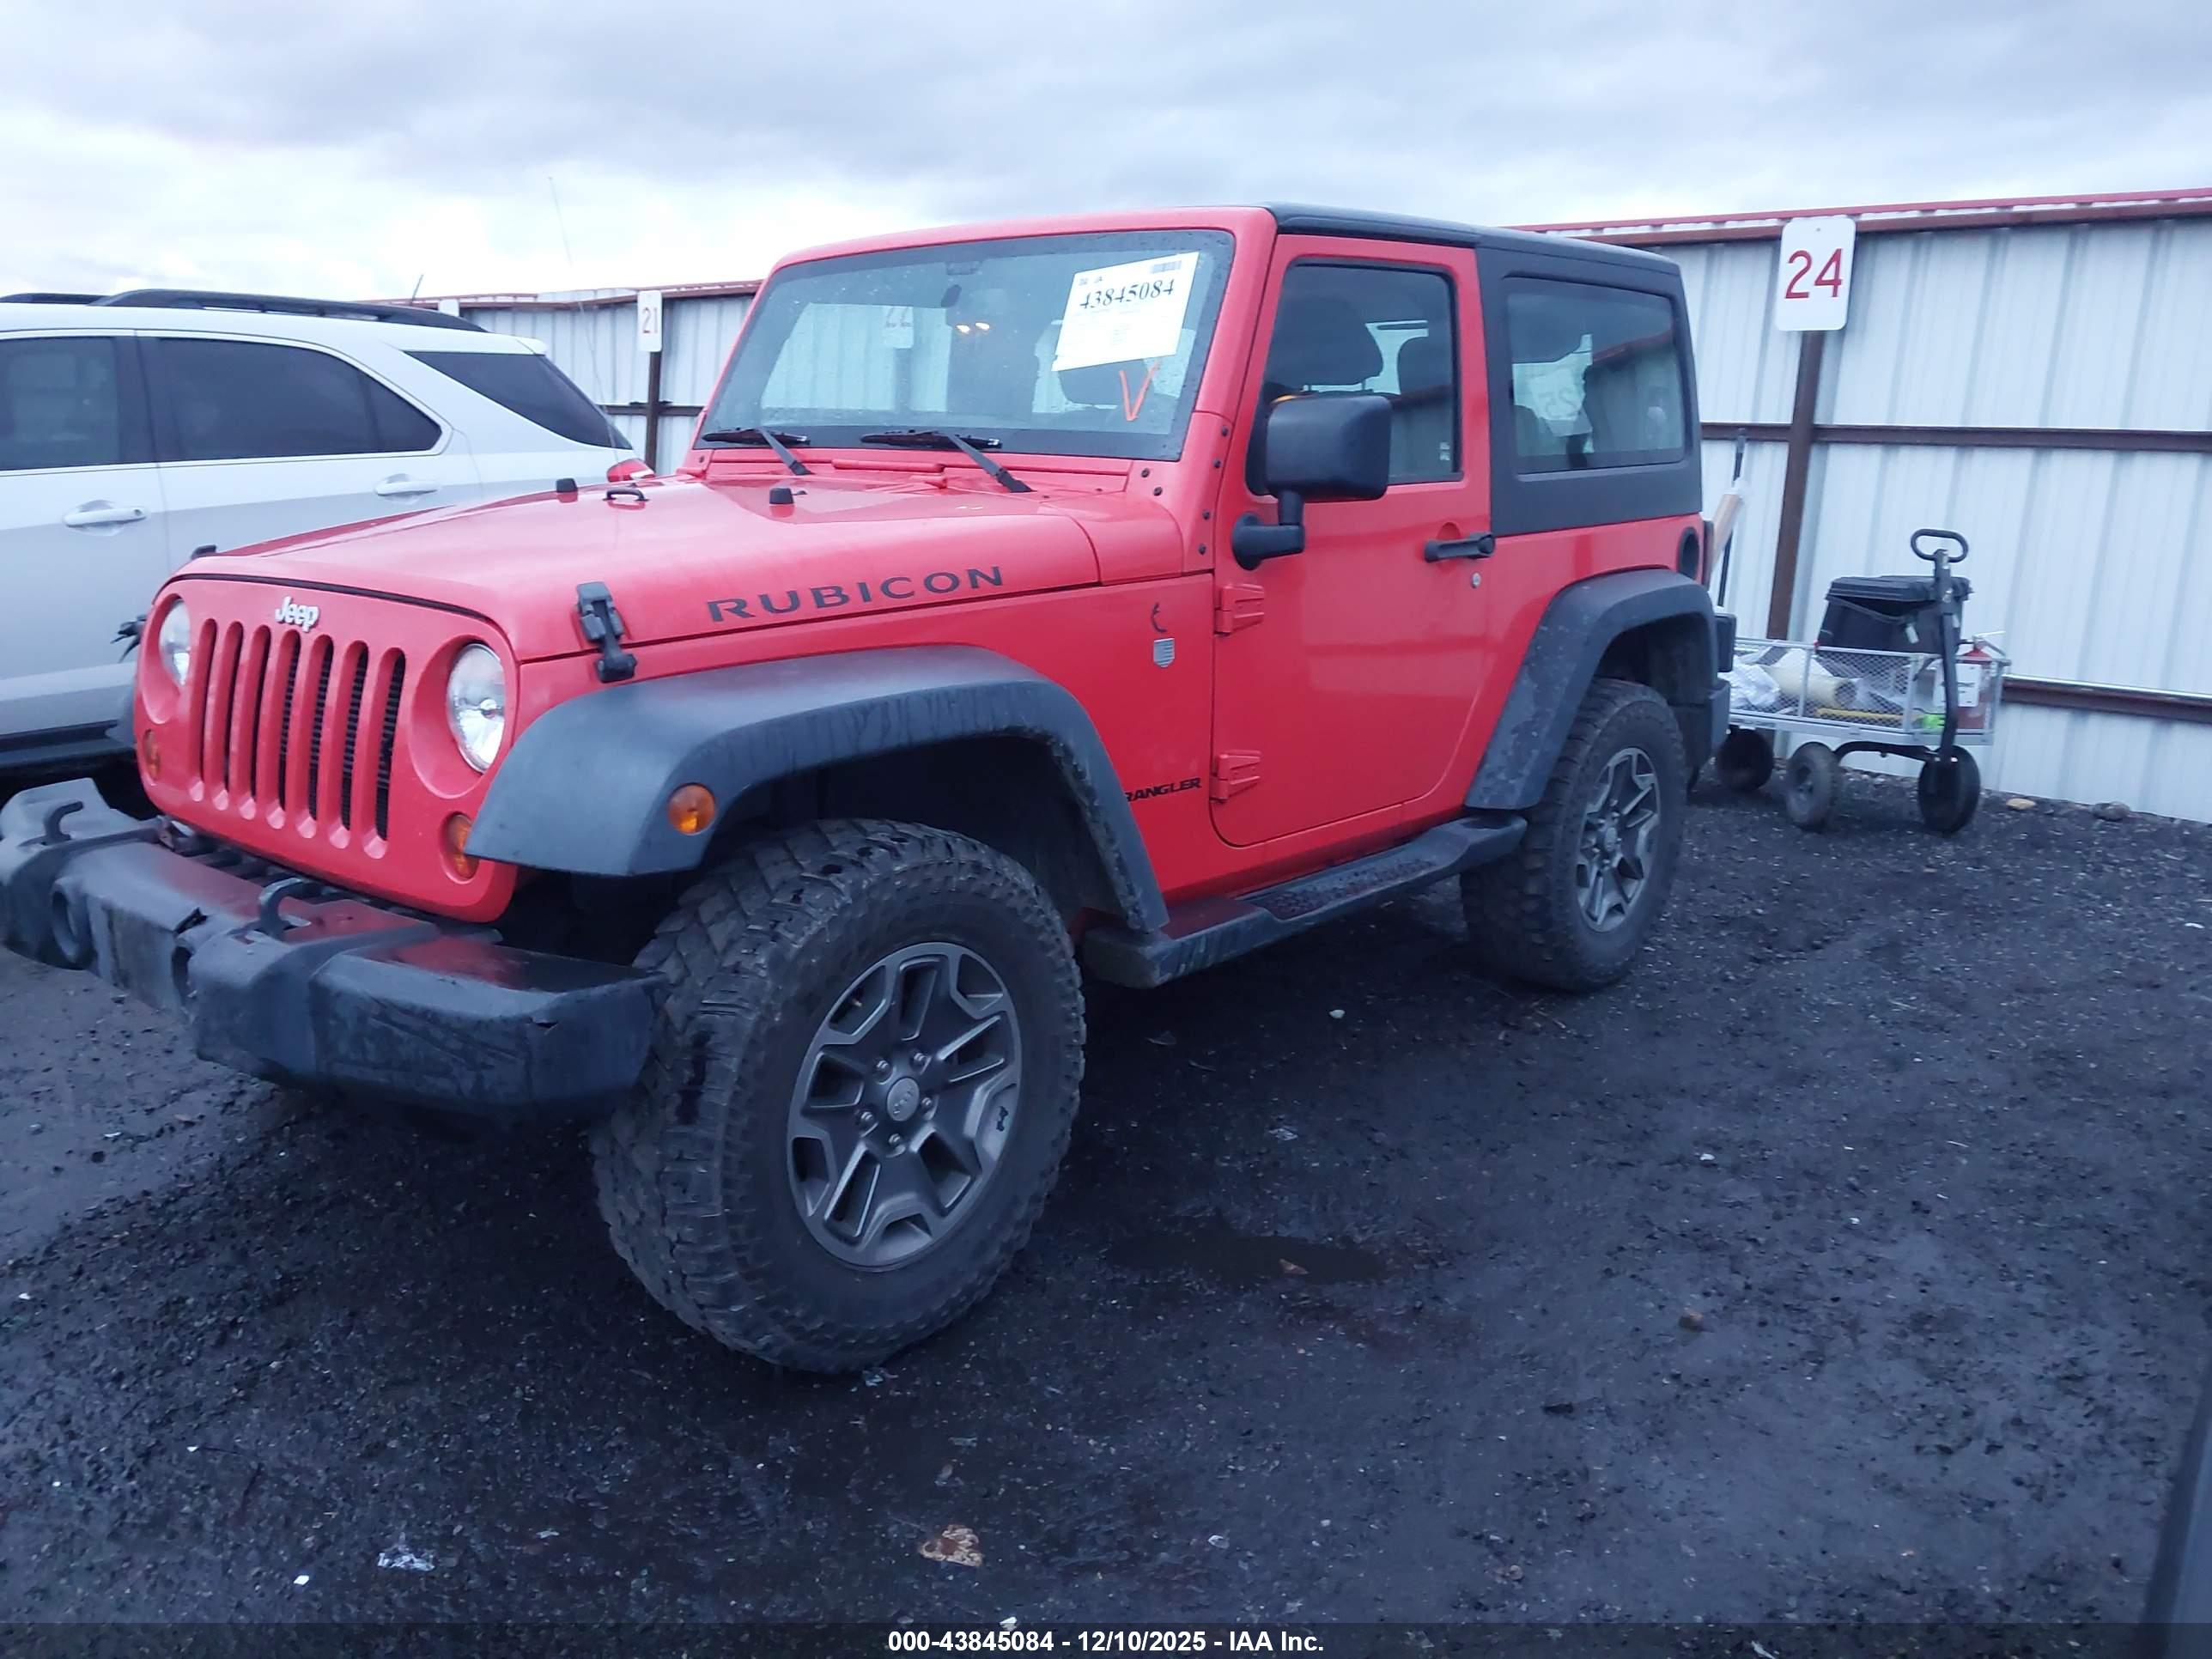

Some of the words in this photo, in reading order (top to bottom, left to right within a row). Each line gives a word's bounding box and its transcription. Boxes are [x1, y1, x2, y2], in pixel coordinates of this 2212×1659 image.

[1784, 248, 1844, 299] 24
[1079, 278, 1175, 309] 43845084
[641, 307, 659, 334] 21
[707, 566, 1004, 622] RUBICON
[275, 596, 319, 632] Jeep
[1124, 777, 1202, 802] RANGLER
